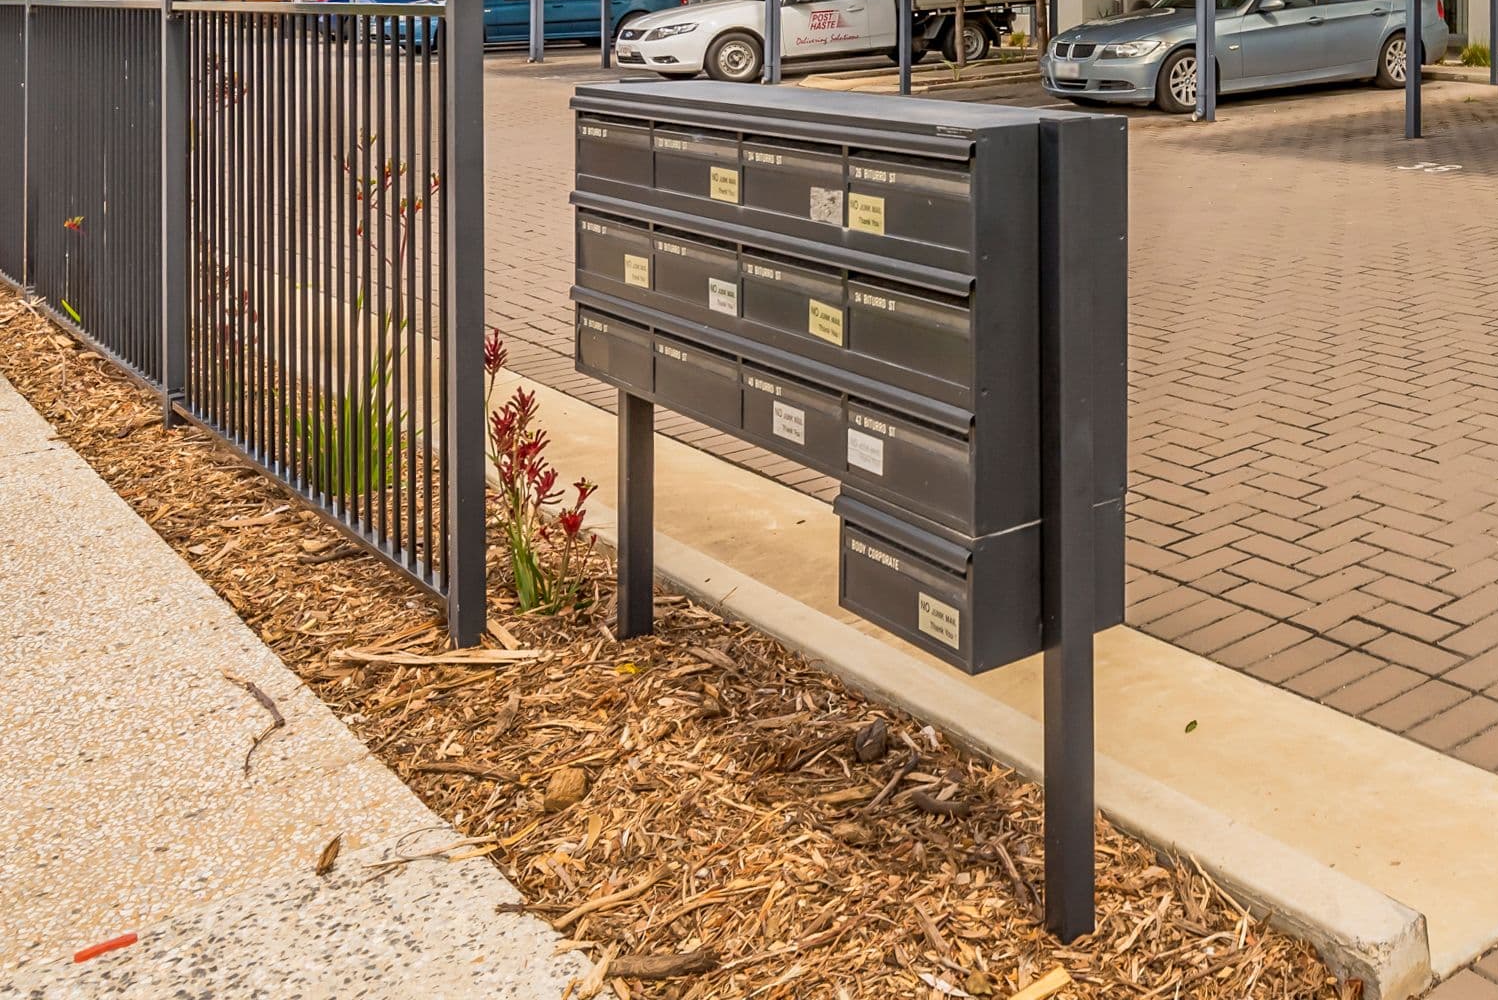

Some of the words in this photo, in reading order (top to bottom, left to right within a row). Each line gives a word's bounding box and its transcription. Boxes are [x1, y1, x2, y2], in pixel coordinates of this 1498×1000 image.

[812, 13, 833, 21] POST
[810, 20, 836, 30] HASTE
[864, 294, 886, 309] BITURRO
[864, 416, 886, 434] BITURRO
[852, 539, 866, 554] BODY
[868, 547, 900, 571] CORPORATE
